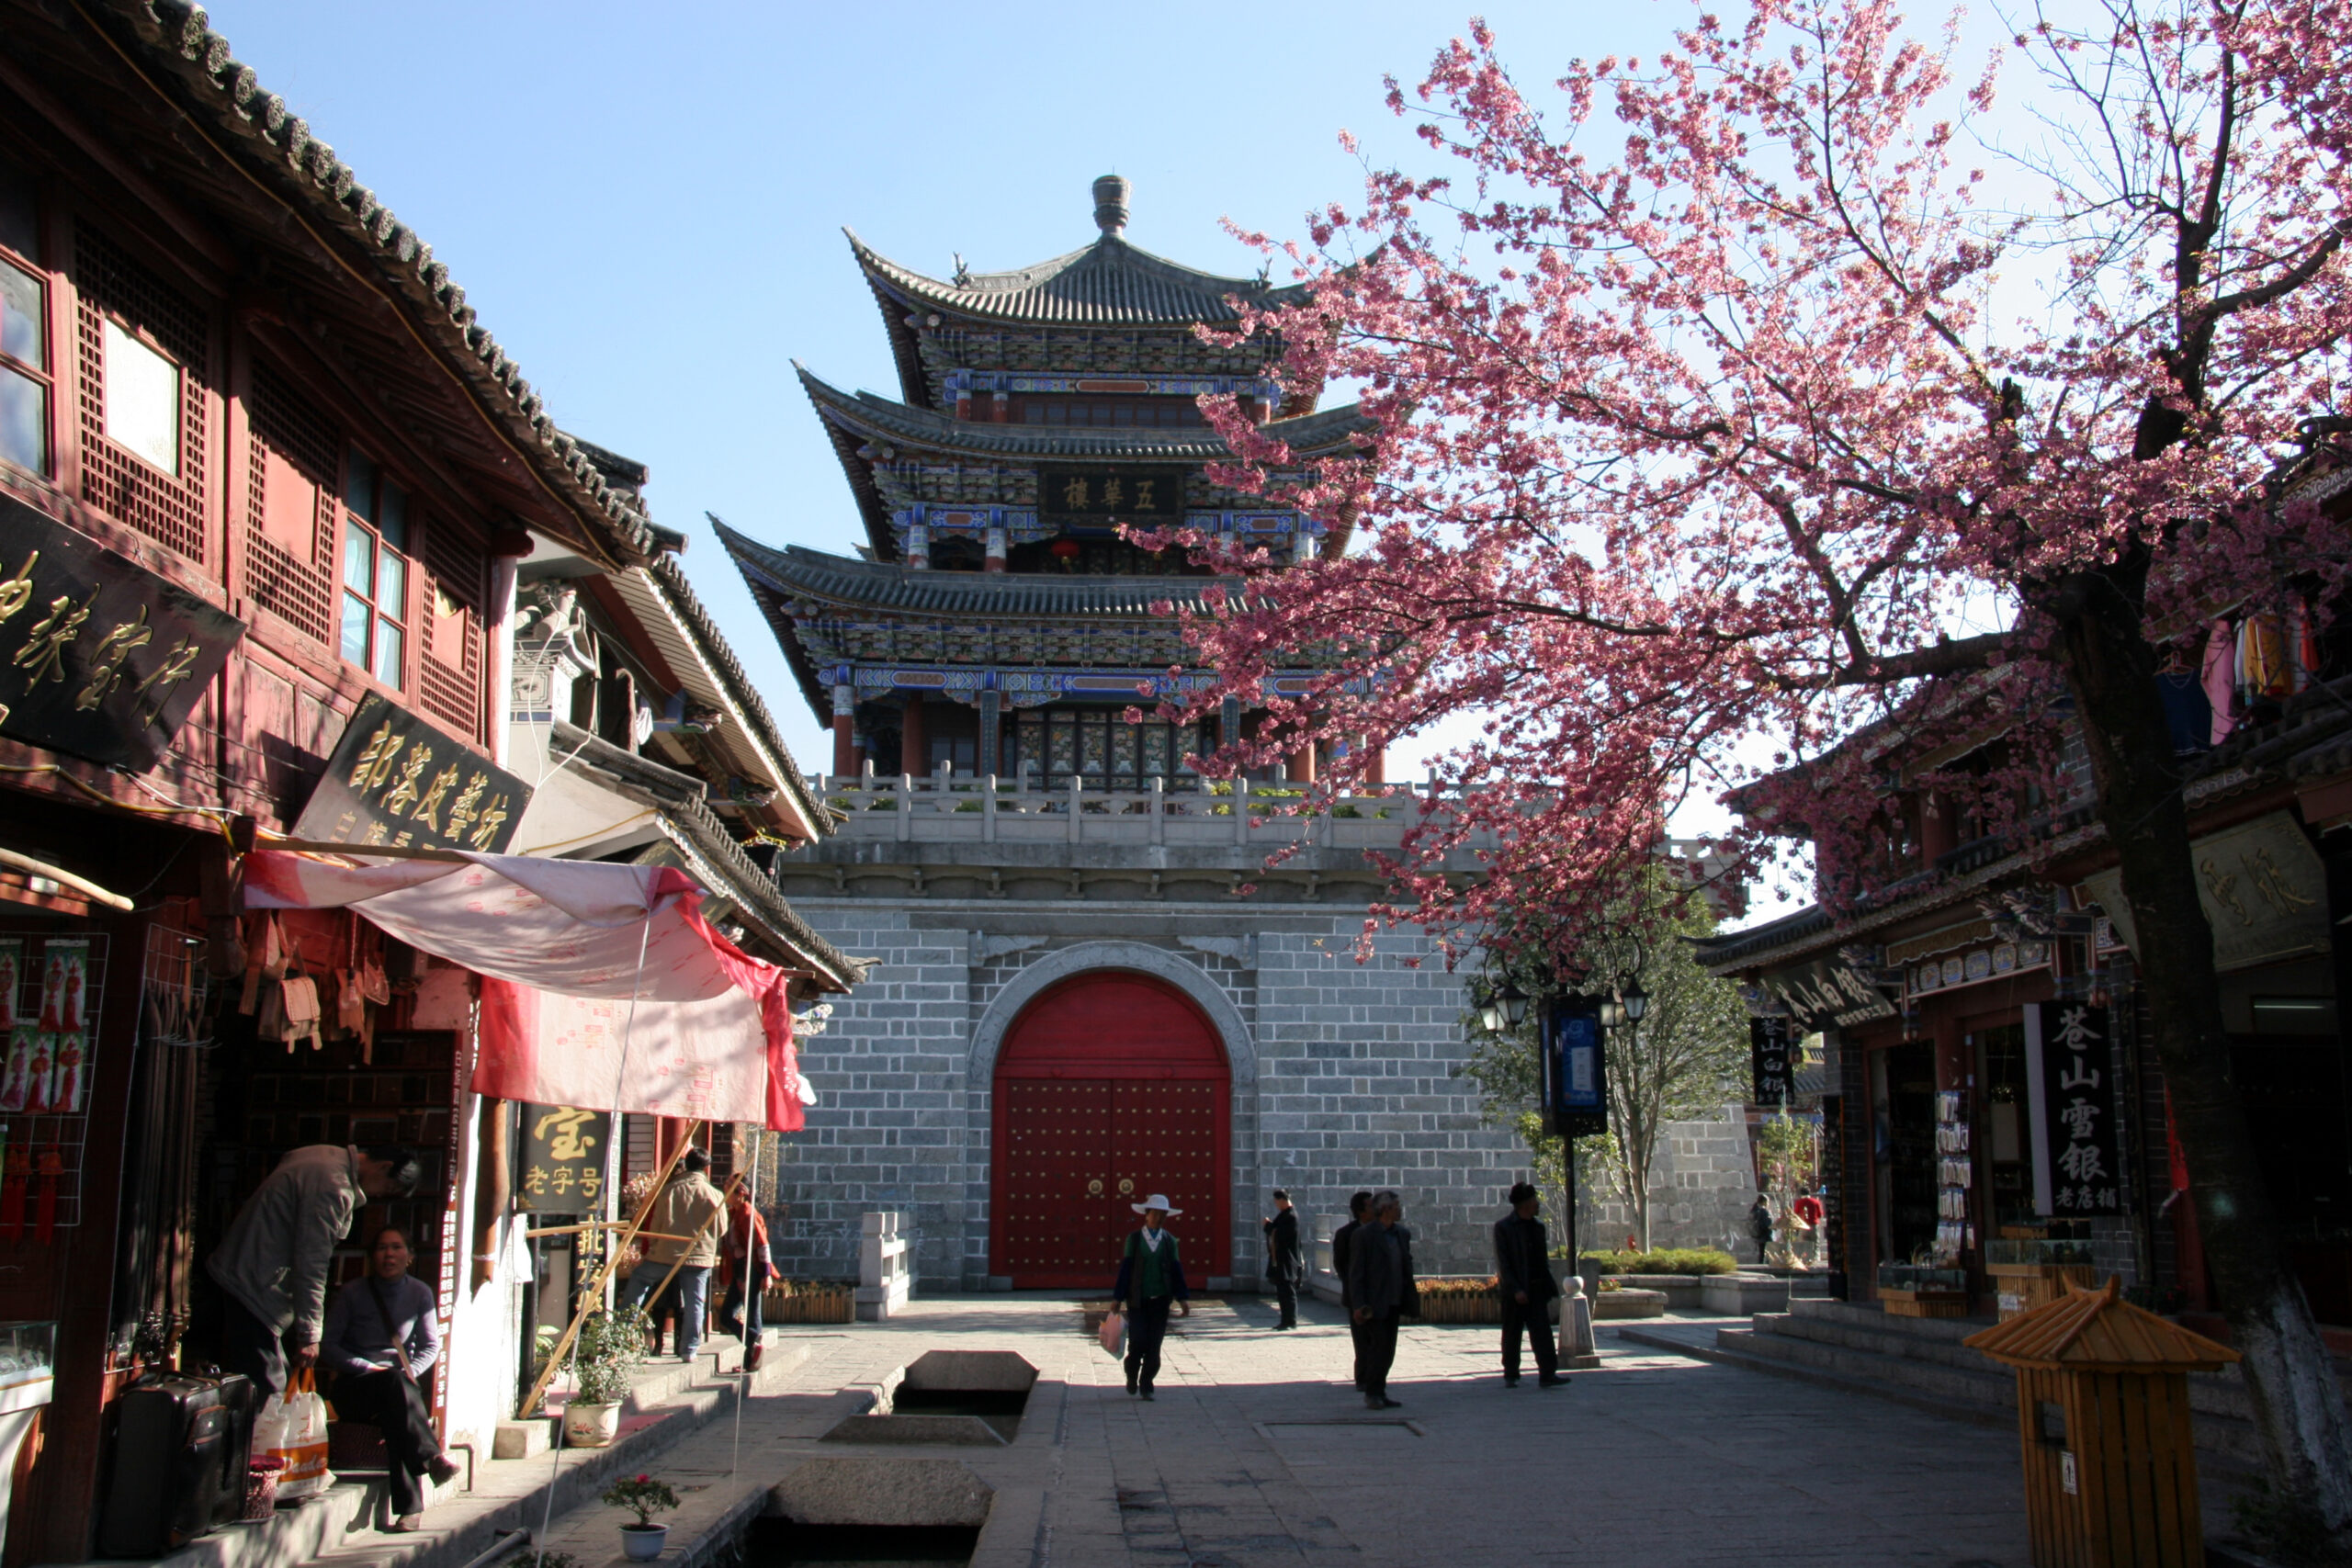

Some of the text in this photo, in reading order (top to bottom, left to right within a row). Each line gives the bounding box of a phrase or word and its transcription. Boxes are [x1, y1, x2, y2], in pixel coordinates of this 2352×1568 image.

[330, 810, 436, 851] 白族手
[2052, 1007, 2109, 1182] 苍山雪银
[524, 1165, 603, 1198] 老字号
